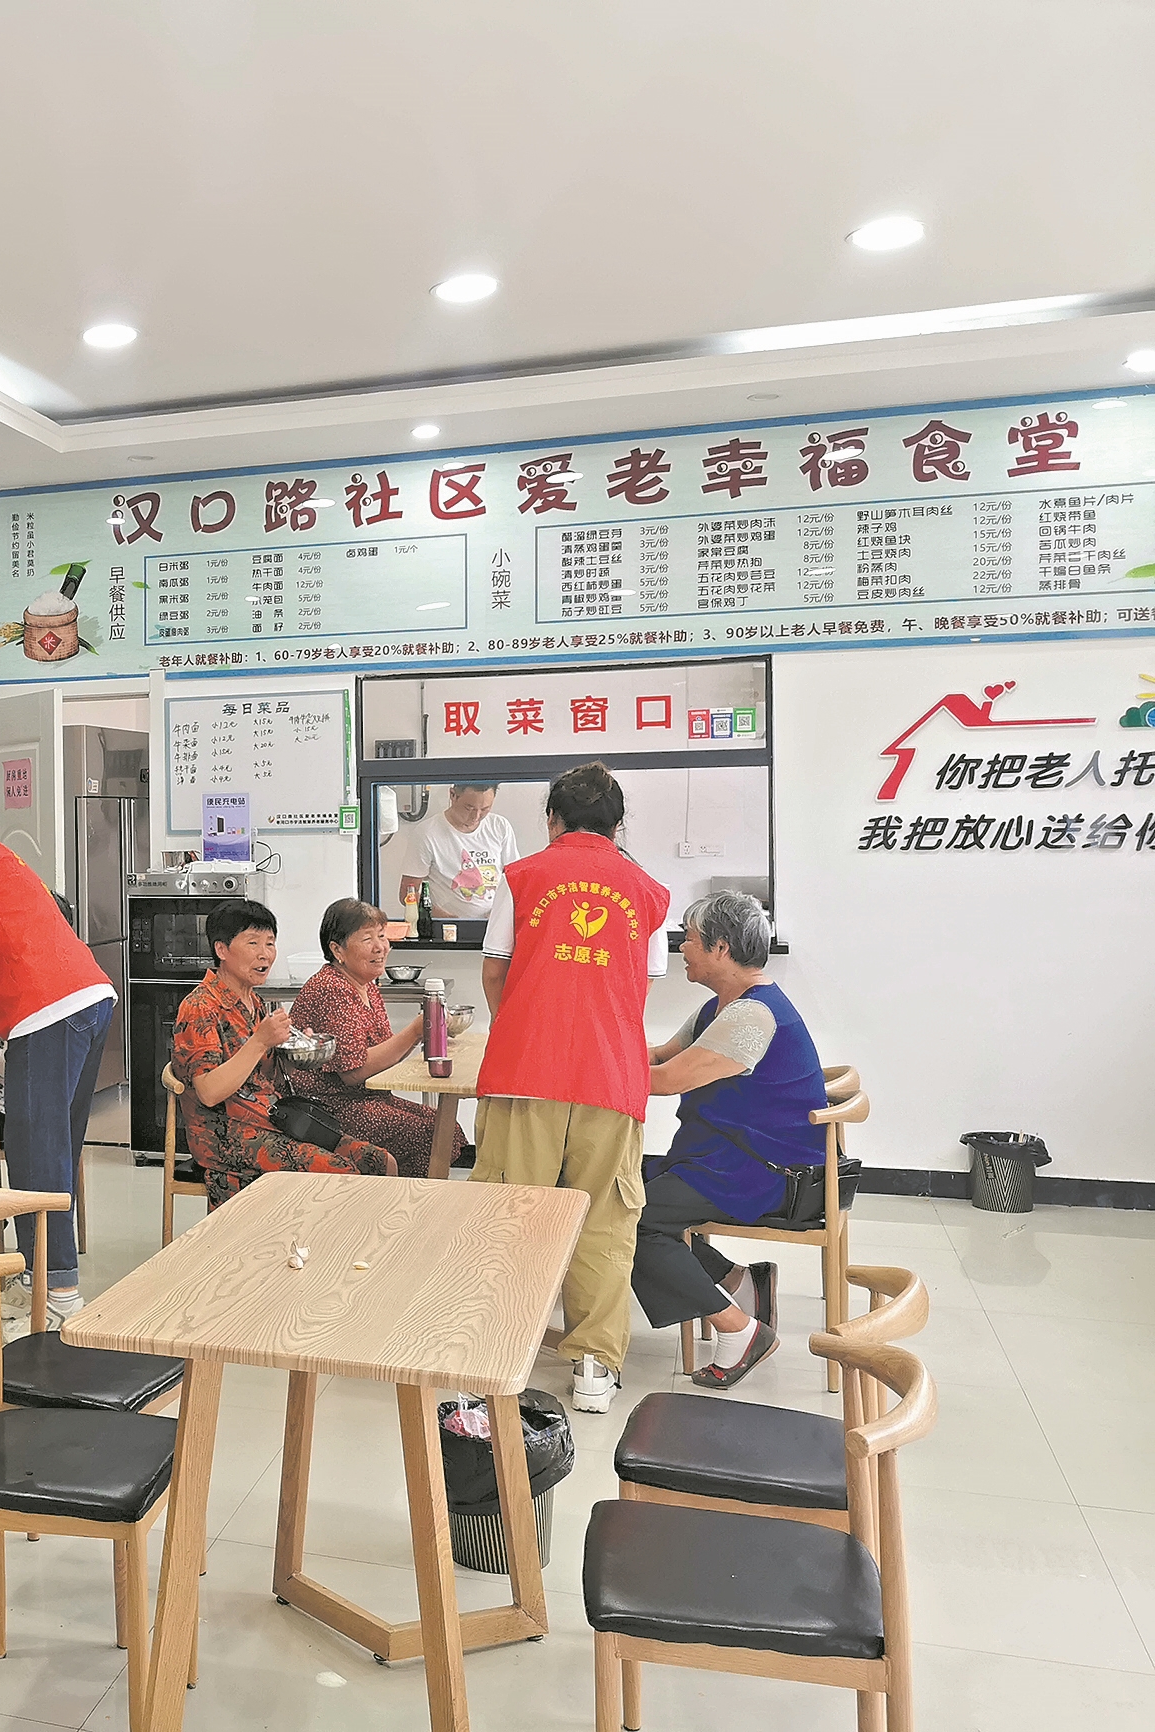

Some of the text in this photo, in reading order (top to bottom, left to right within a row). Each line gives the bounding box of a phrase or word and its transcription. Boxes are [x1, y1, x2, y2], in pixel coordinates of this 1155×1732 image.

[110, 411, 1081, 546] 汉口路社区爱老幸福食堂
[973, 500, 1013, 512] 12元/份
[1039, 493, 1134, 510] 水煮鱼片/肉片
[797, 512, 835, 524] 12元/份
[973, 514, 1013, 525] 12元/份
[1039, 510, 1096, 524] 红烧带鱼
[639, 525, 669, 536] 3元/份
[797, 526, 835, 537] 12元/份
[857, 522, 898, 534] 辣子鸡
[973, 528, 1013, 539] 15元/份
[1039, 524, 1096, 537] 回锅牛肉
[639, 538, 669, 548] 3元/份
[803, 539, 835, 550] 8元/份
[857, 534, 911, 548] 红烧鱼块
[346, 546, 379, 558] 卤鸡蛋
[395, 544, 419, 554] 1元/个
[973, 542, 1013, 553] 15元/份
[251, 553, 283, 564] 豆腐面
[298, 552, 323, 561] 4元/份
[639, 550, 669, 562] 3元/份
[803, 552, 835, 564] 8元/份
[857, 548, 911, 561] 土豆烧肉
[159, 561, 189, 572] 白米粥
[207, 558, 229, 568] 1元/份
[973, 556, 1013, 567] 20元/份
[251, 567, 283, 578] 热干面
[298, 566, 323, 574] 4元/份
[639, 564, 669, 574] 3元/份
[857, 562, 898, 574] 粉蒸肉
[207, 576, 229, 584] 1元/份
[491, 548, 511, 610] 小碗菜
[973, 570, 1013, 580] 22元/份
[159, 578, 189, 588] 南瓜粥
[251, 581, 283, 592] 牛肉面
[296, 580, 323, 589] 12元/份
[639, 576, 669, 586] 5元/份
[797, 579, 835, 590] 12元/份
[973, 583, 1013, 594] 12元/份
[159, 594, 189, 604] 黑米粥
[207, 592, 229, 601] 2元/份
[298, 594, 323, 603] 5元/份
[639, 589, 669, 600] 5元/份
[803, 592, 835, 604] 5元/份
[109, 566, 126, 641] 早餐供应
[639, 602, 669, 612] 5元/份
[159, 610, 189, 621] 绿豆粥
[207, 608, 229, 618] 2元/份
[298, 608, 323, 616] 2元/份
[207, 626, 229, 634] 3元/份
[298, 622, 323, 630] 2元/份
[222, 701, 290, 716] 每日菜品
[444, 694, 673, 737] 取菜窗口
[554, 943, 611, 967] 志愿者
